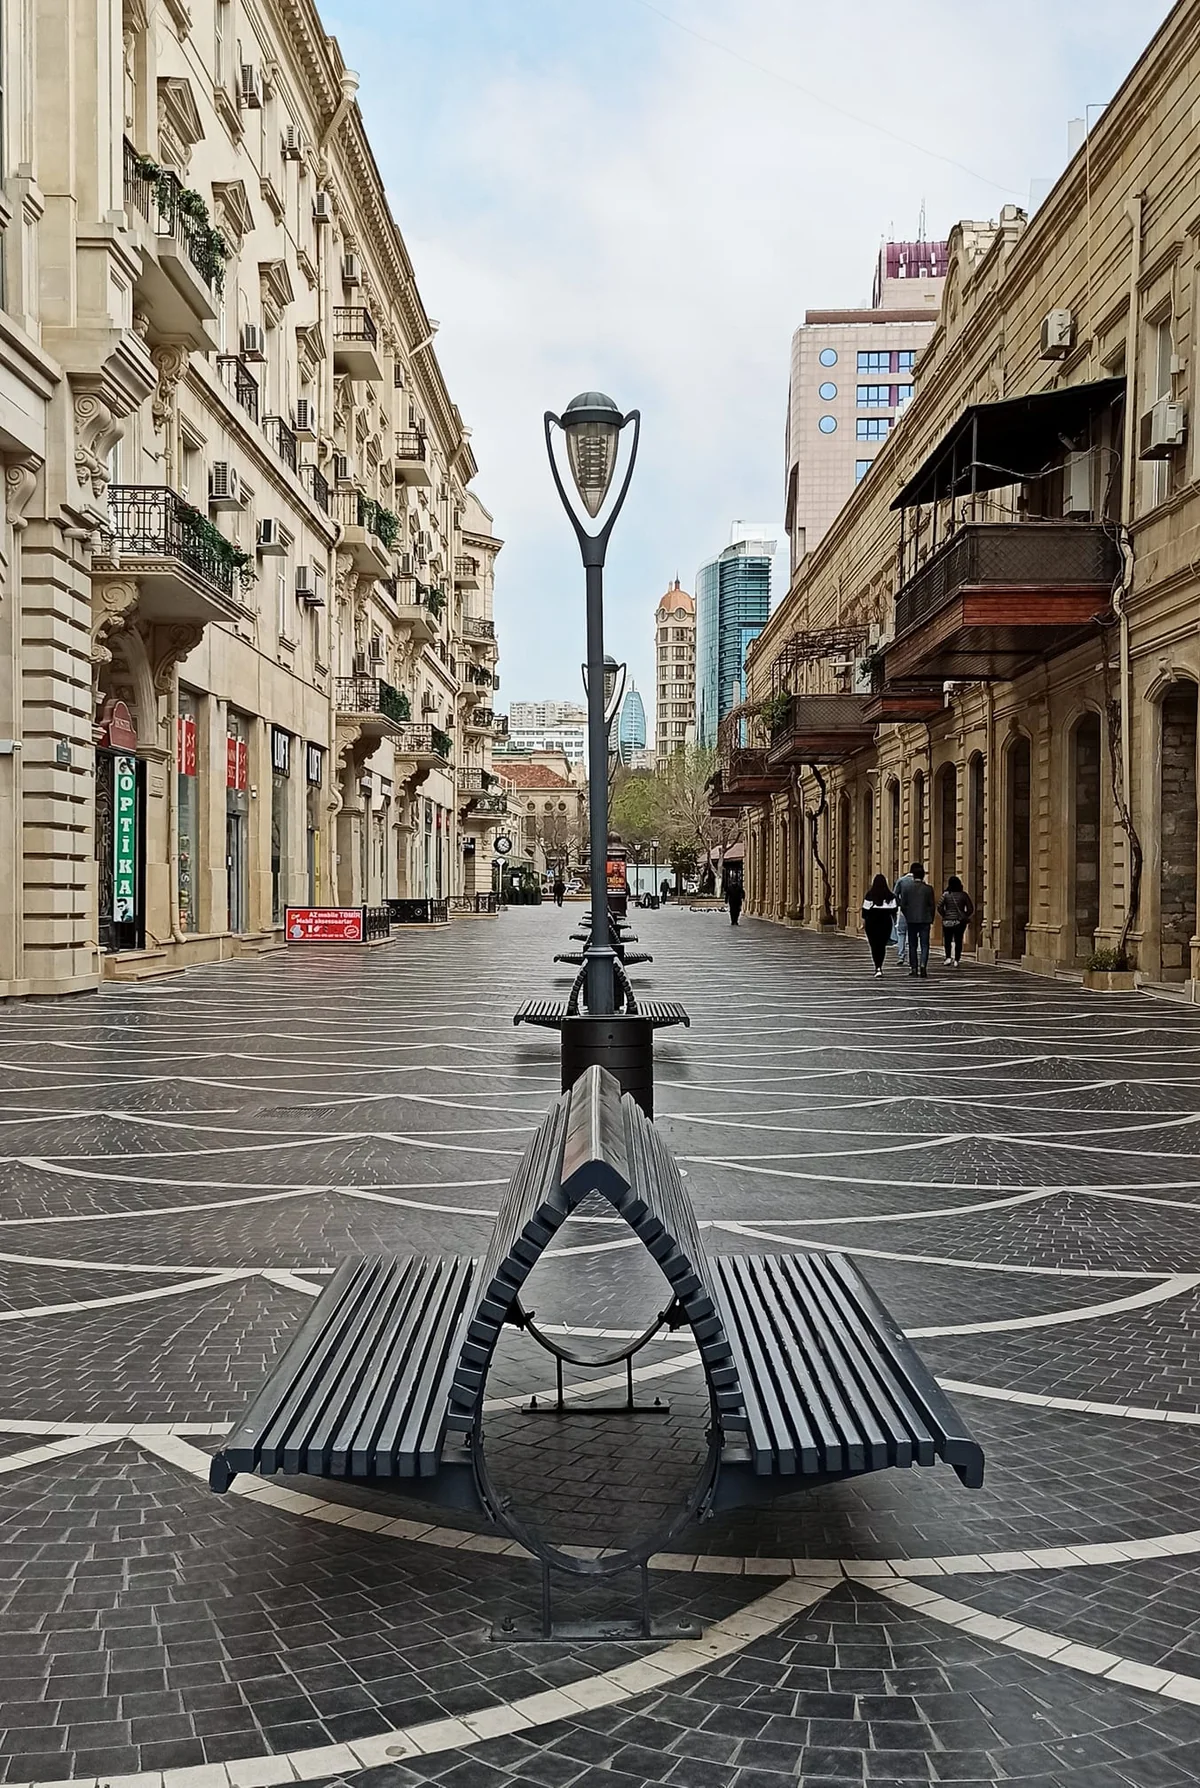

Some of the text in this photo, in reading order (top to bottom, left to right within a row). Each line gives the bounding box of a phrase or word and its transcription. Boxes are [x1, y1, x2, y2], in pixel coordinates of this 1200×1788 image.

[274, 730, 289, 770] LOFT
[309, 747, 321, 783] LOFT
[119, 776, 134, 895] OPTİKA
